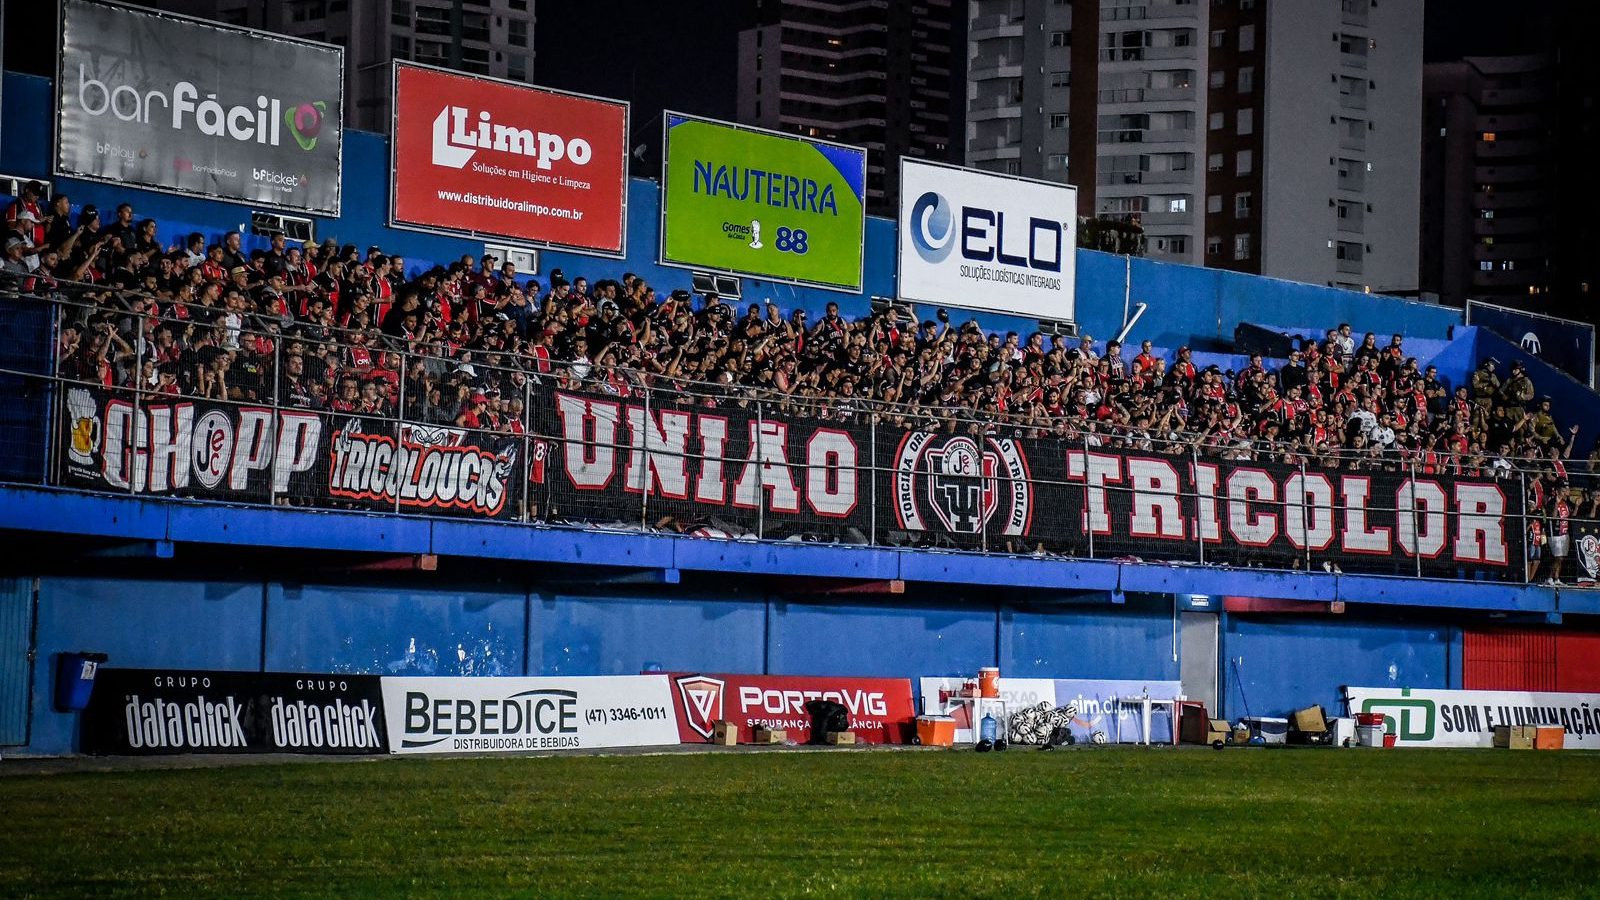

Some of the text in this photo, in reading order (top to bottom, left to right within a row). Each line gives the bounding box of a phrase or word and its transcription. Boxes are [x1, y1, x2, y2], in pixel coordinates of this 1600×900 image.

[451, 106, 592, 170] Limpo
[252, 167, 298, 187] bfticket
[472, 161, 507, 176] Soluções
[508, 169, 520, 178] em
[522, 169, 551, 183] Higiene
[559, 175, 591, 190] Limpeza
[693, 159, 838, 217] NAUTERRA
[437, 189, 584, 221] www.distribuidoralimpo.com.br
[722, 221, 751, 234] Gomes
[776, 226, 809, 255] 88
[961, 205, 1062, 273] ELO
[960, 264, 1061, 291] SOLUÇÕES LOGÍSTICAS INTEGRADAS
[554, 390, 858, 518] UNIÃO
[1066, 449, 1510, 566] TRICOLOR
[154, 676, 211, 688] GRUPO
[296, 679, 348, 692] GRUPO
[405, 691, 578, 735] BEBEDICE
[585, 706, 667, 725] (47) 3346-1011
[1440, 704, 1482, 733] SOM
[453, 736, 580, 750] DISTRIBUIDORA DE BEBIDAS
